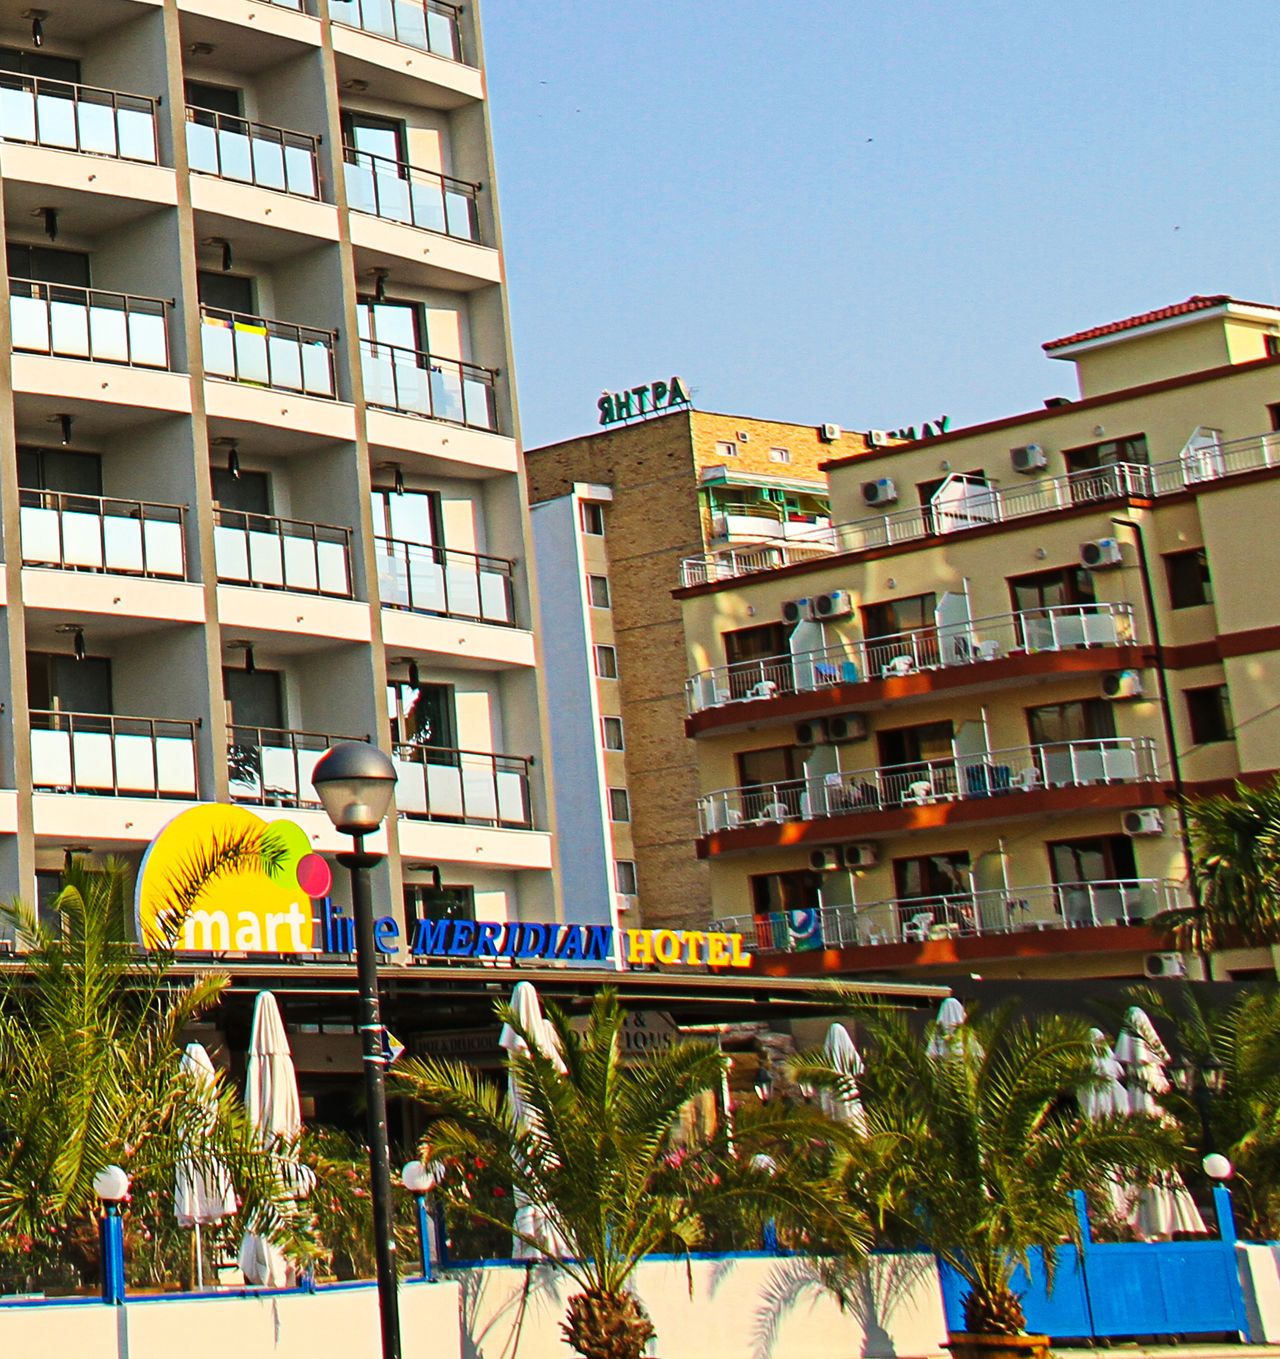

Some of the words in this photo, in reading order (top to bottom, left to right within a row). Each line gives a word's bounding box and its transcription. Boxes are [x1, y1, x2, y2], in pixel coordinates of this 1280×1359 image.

[597, 376, 690, 425] ЯНТРА
[412, 919, 614, 961] MERIDIAN
[626, 928, 753, 968] HOTEL
